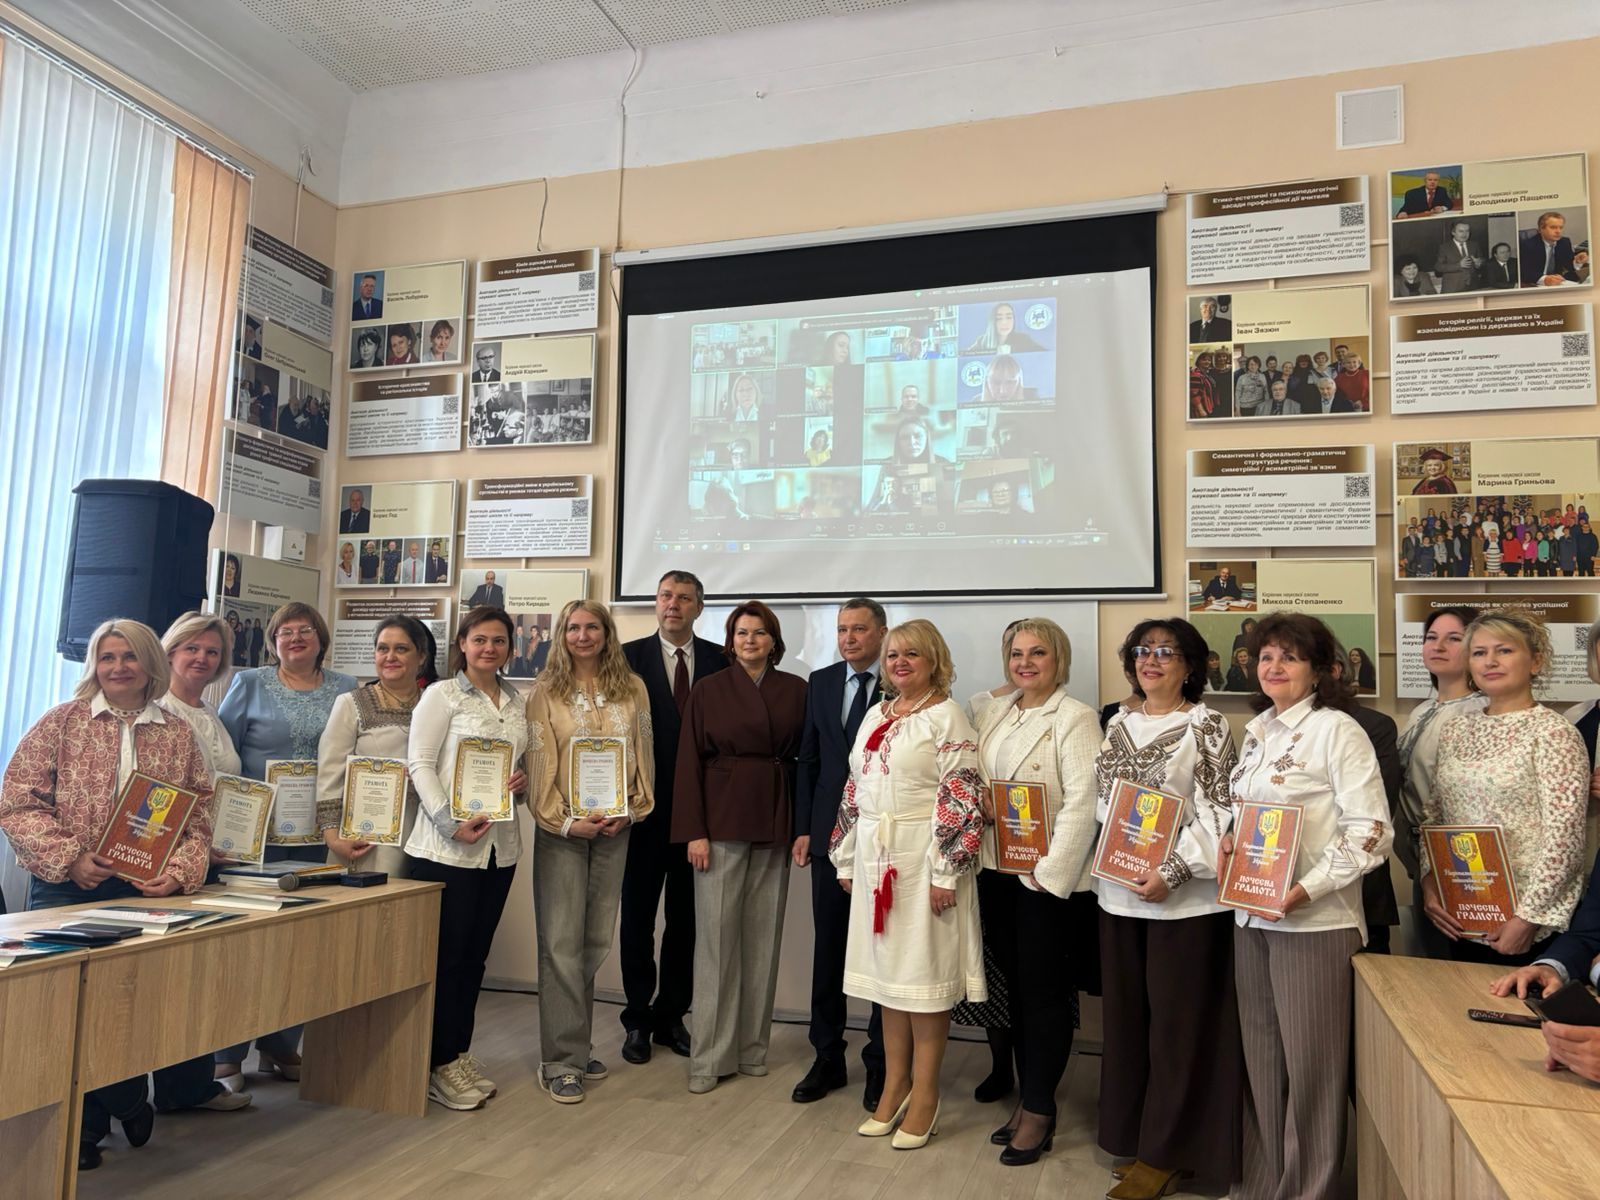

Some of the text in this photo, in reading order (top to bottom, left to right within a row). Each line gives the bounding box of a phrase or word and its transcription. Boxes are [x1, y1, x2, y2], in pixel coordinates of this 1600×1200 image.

[1213, 193, 1268, 204] Етико-естетичні
[1291, 195, 1300, 203] дії
[1469, 193, 1559, 206] Володимир Пащенко
[1488, 321, 1529, 330] державою
[1536, 318, 1564, 327] Україні
[1495, 315, 1522, 323] церкви
[1260, 450, 1346, 459] формально-граматична
[1478, 478, 1555, 487] Марина Гриньова
[1532, 601, 1568, 609] успішної
[115, 843, 152, 860] ПОЧЕСНА
[107, 849, 152, 870] ГРАМОТА
[1114, 850, 1150, 868] ПОЧЕСНА
[1240, 875, 1274, 888] ПОЧЕСНА
[1234, 882, 1276, 897] ГРАМОТА
[1458, 903, 1501, 913] ПОЧЕСНА
[1456, 911, 1506, 922] ГРАМОТА
